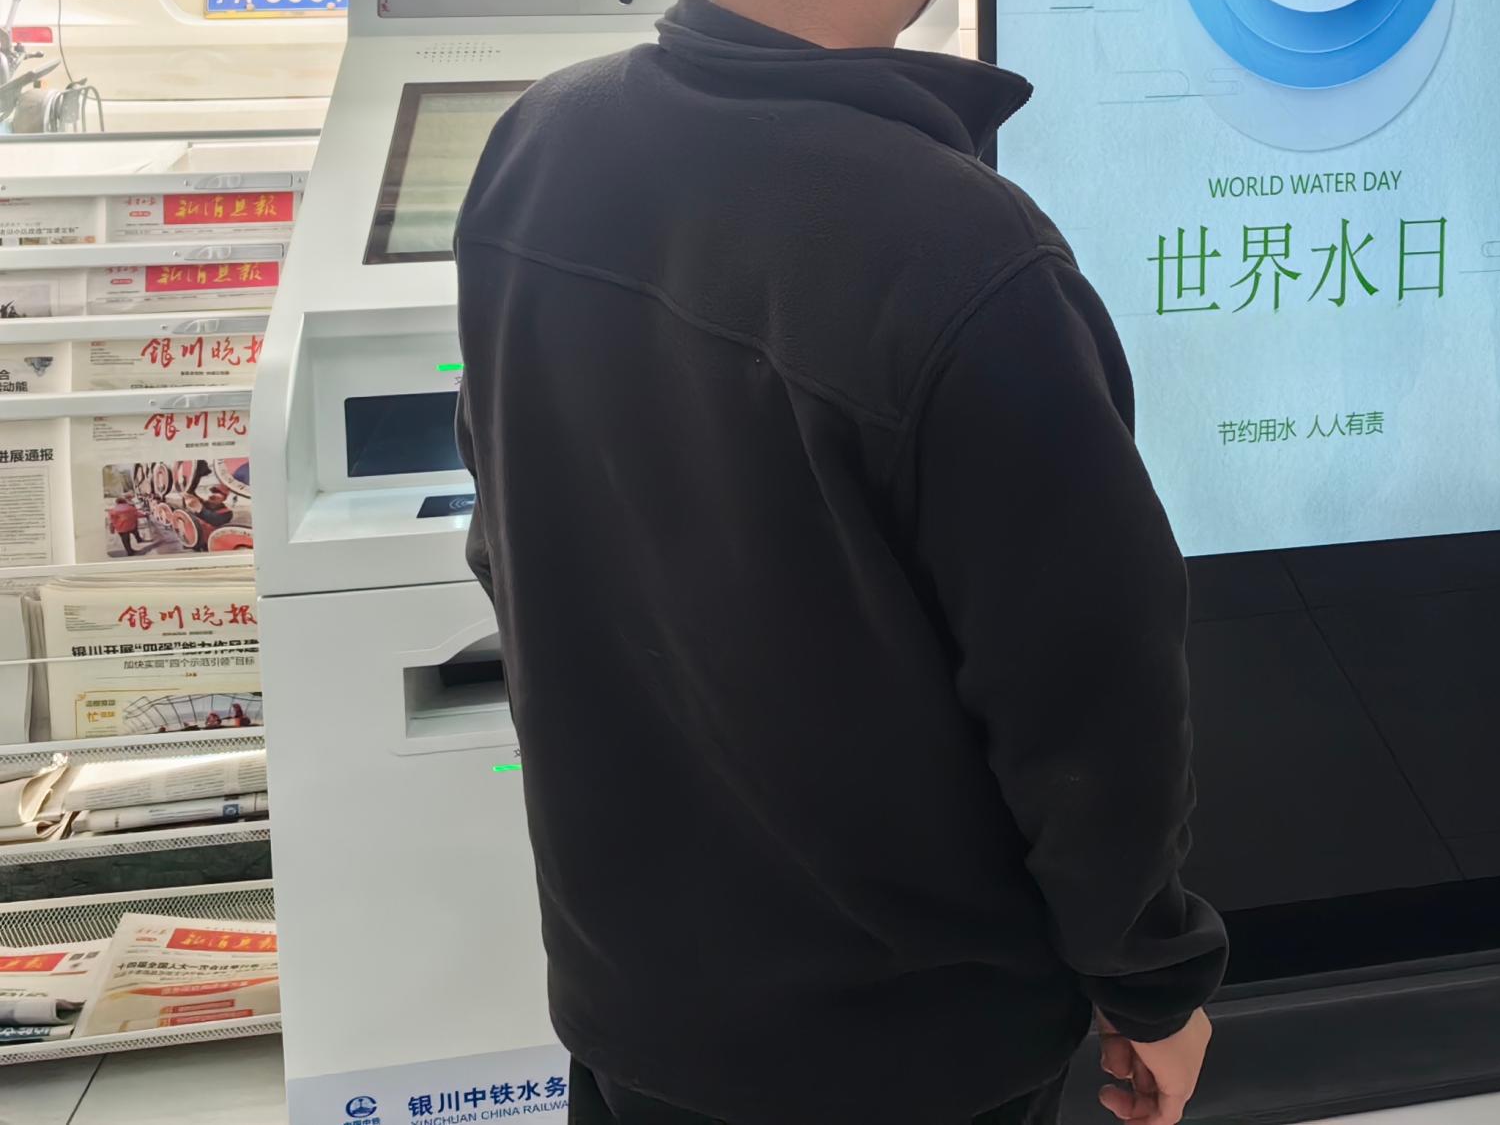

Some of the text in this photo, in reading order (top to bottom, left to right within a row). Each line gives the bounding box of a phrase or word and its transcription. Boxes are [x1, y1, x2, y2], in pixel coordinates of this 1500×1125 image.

[1208, 170, 1402, 198] WORLD WATER DAY
[1147, 217, 1447, 315] 世界水日
[1217, 410, 1385, 446] 节约用水 人人有责
[408, 1076, 568, 1118] 银川中铁水务
[481, 1106, 520, 1121] CHINA
